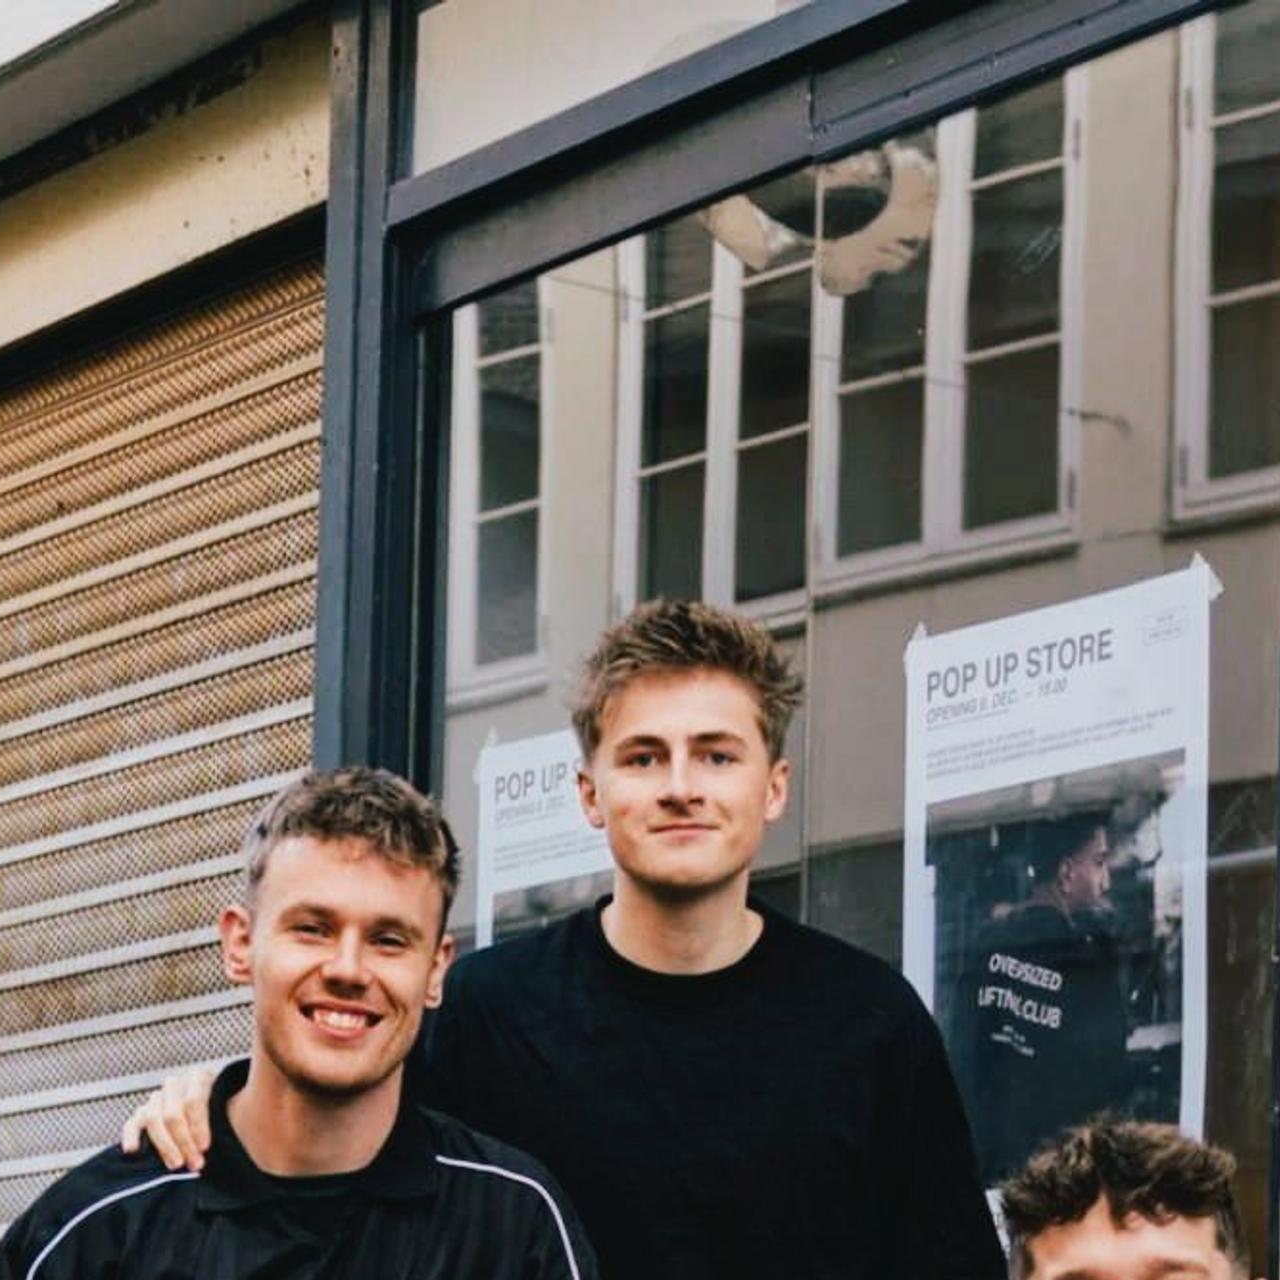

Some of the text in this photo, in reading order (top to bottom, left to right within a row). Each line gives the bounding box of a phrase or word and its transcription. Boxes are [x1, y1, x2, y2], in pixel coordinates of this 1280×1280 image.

[926, 628, 1113, 703] POP UP STORE
[495, 770, 535, 804] POP
[541, 762, 567, 794] UP
[1023, 999, 1062, 1029] CLUB
